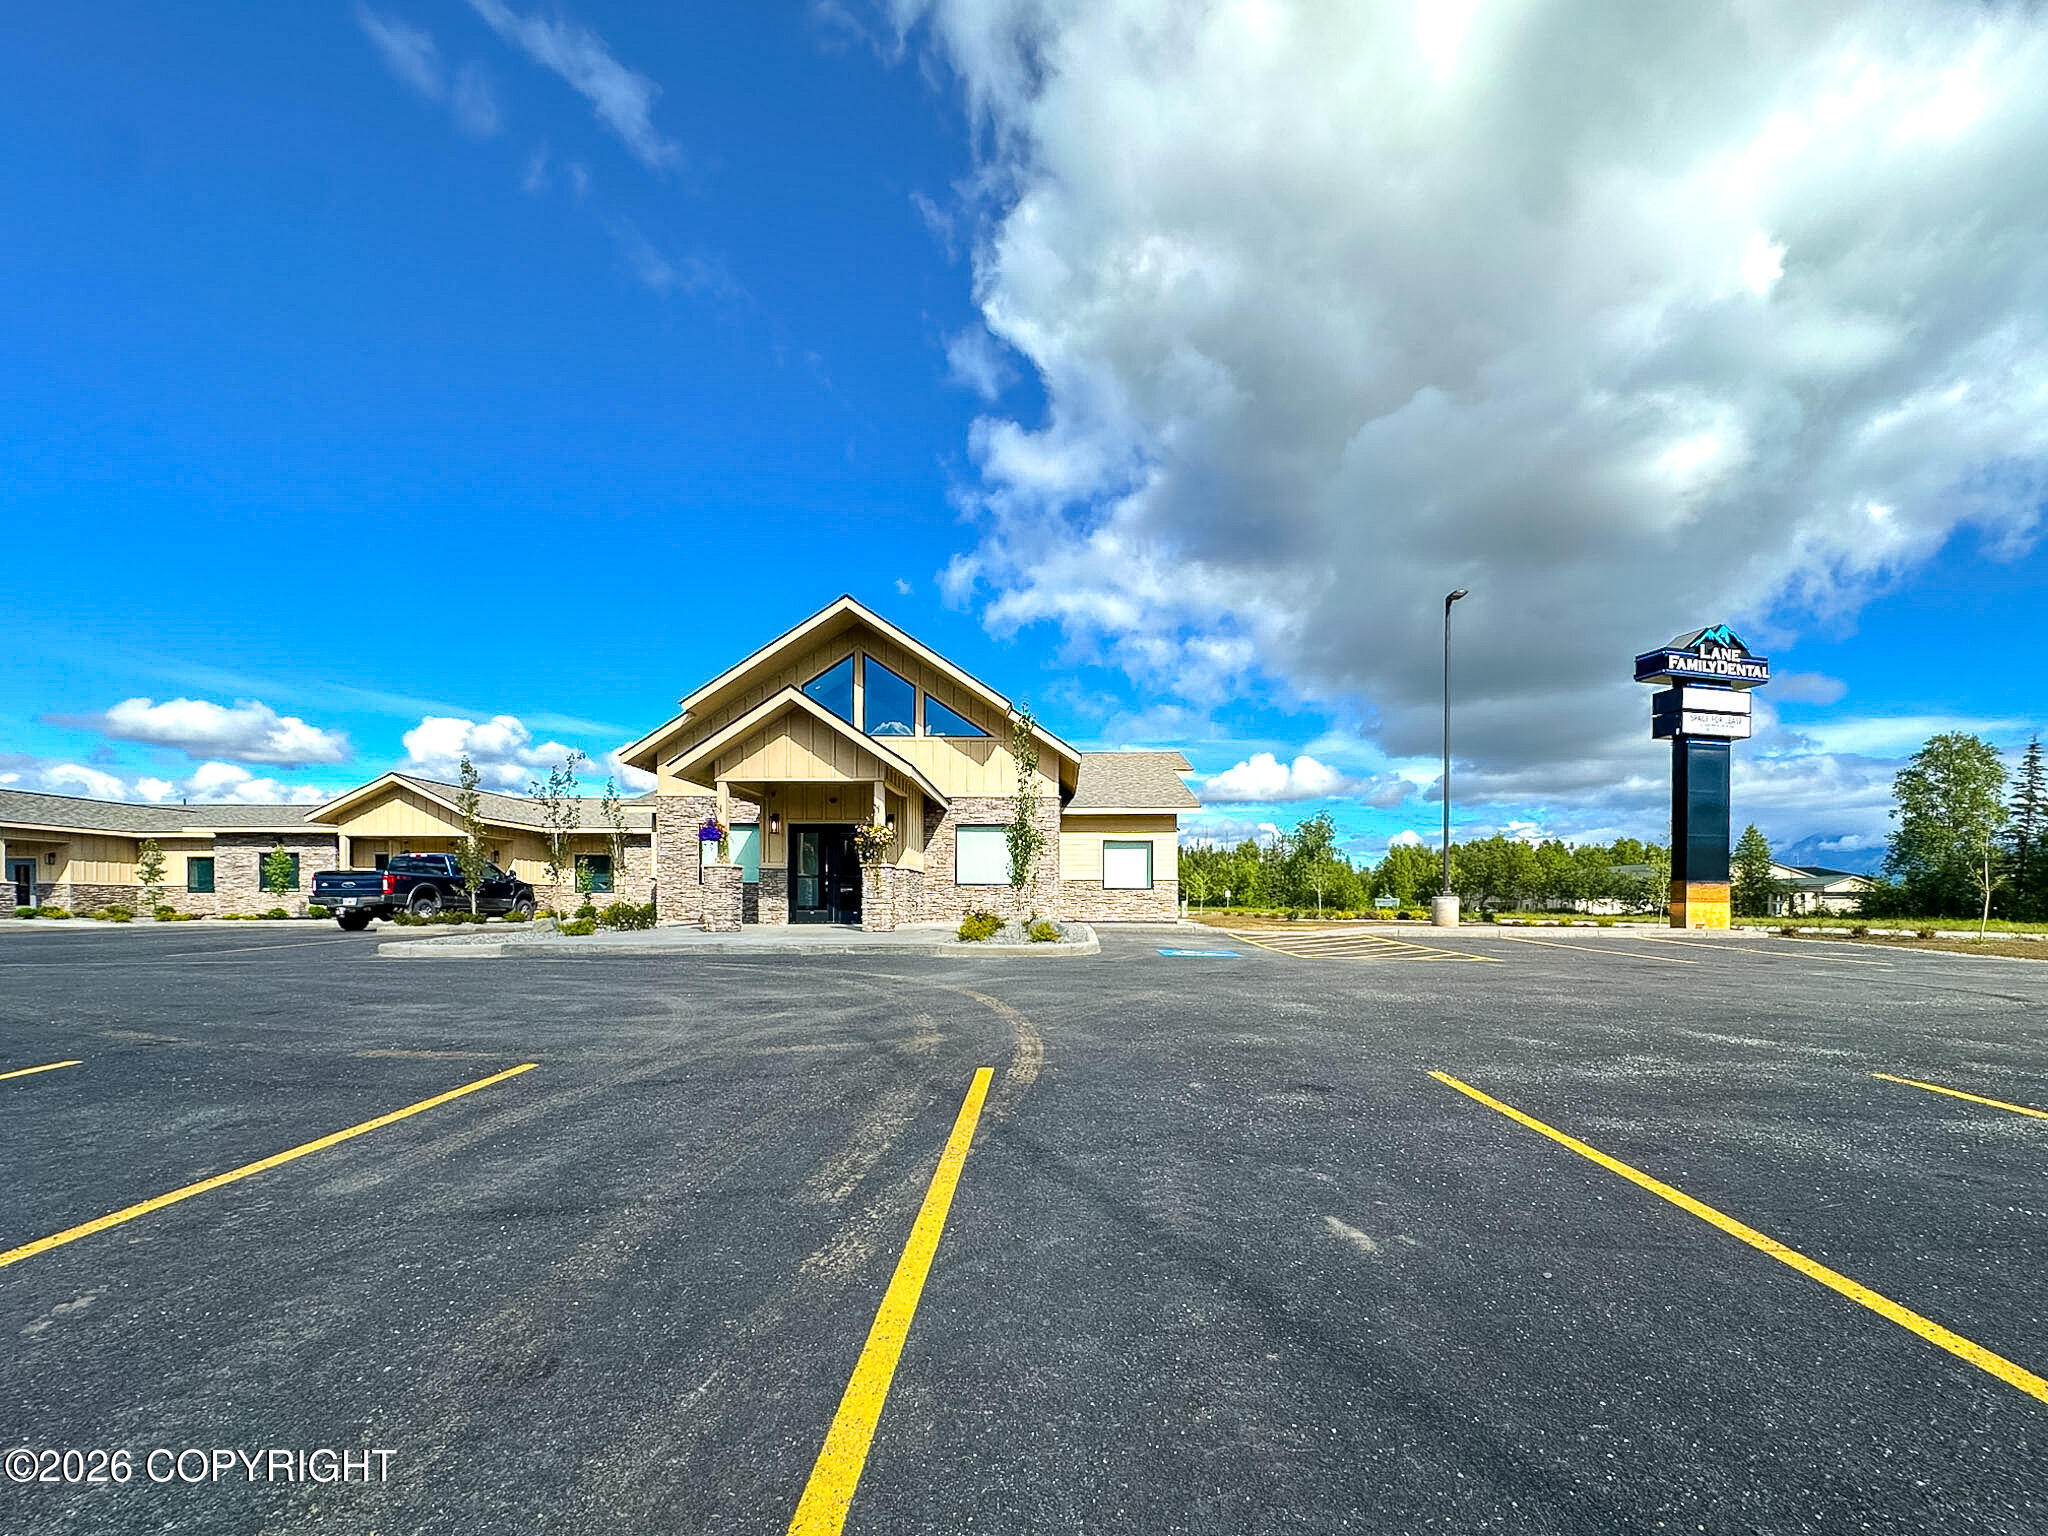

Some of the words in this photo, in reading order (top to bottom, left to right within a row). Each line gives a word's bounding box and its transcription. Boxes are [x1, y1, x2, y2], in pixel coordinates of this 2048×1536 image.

[1700, 643, 1741, 662] LANE
[1668, 655, 1717, 673] FAMILY
[1716, 660, 1770, 678] DENTAL
